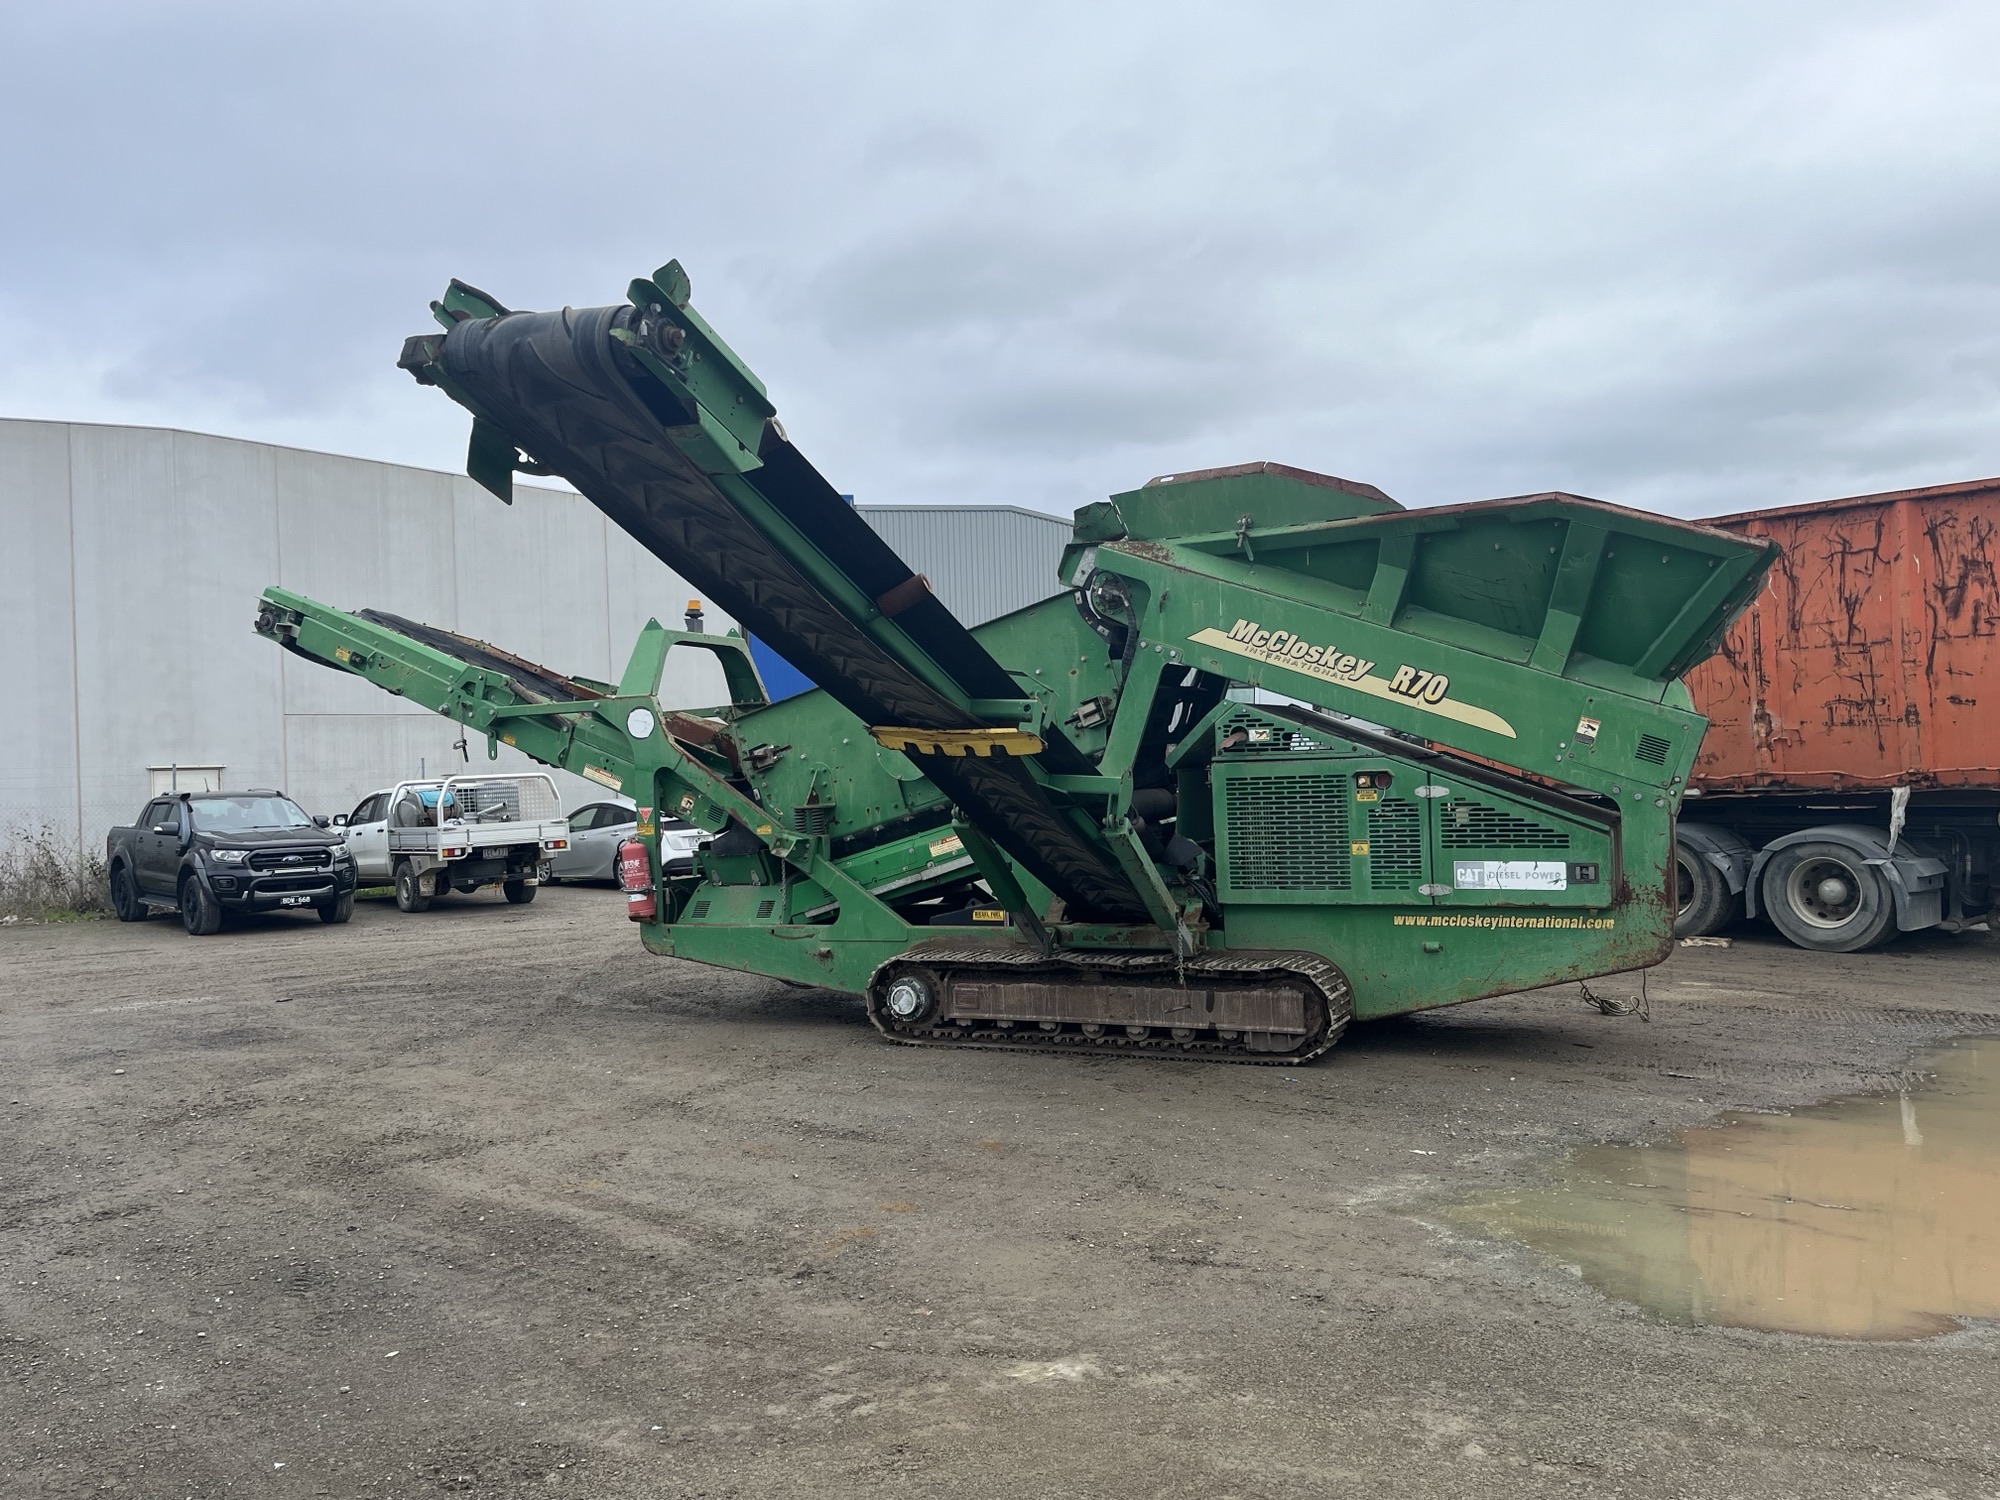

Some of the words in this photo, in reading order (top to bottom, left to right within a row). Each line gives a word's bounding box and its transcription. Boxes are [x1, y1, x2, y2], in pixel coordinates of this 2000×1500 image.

[1226, 618, 1376, 682] McCloskey
[1388, 663, 1450, 705] R70
[1244, 645, 1346, 681] INTERNATIONAL
[1456, 868, 1483, 882] CAT
[1488, 871, 1521, 880] DIESEL
[1525, 871, 1561, 880] POWER
[1393, 914, 1615, 931] www.mccloskeyinternational.com
